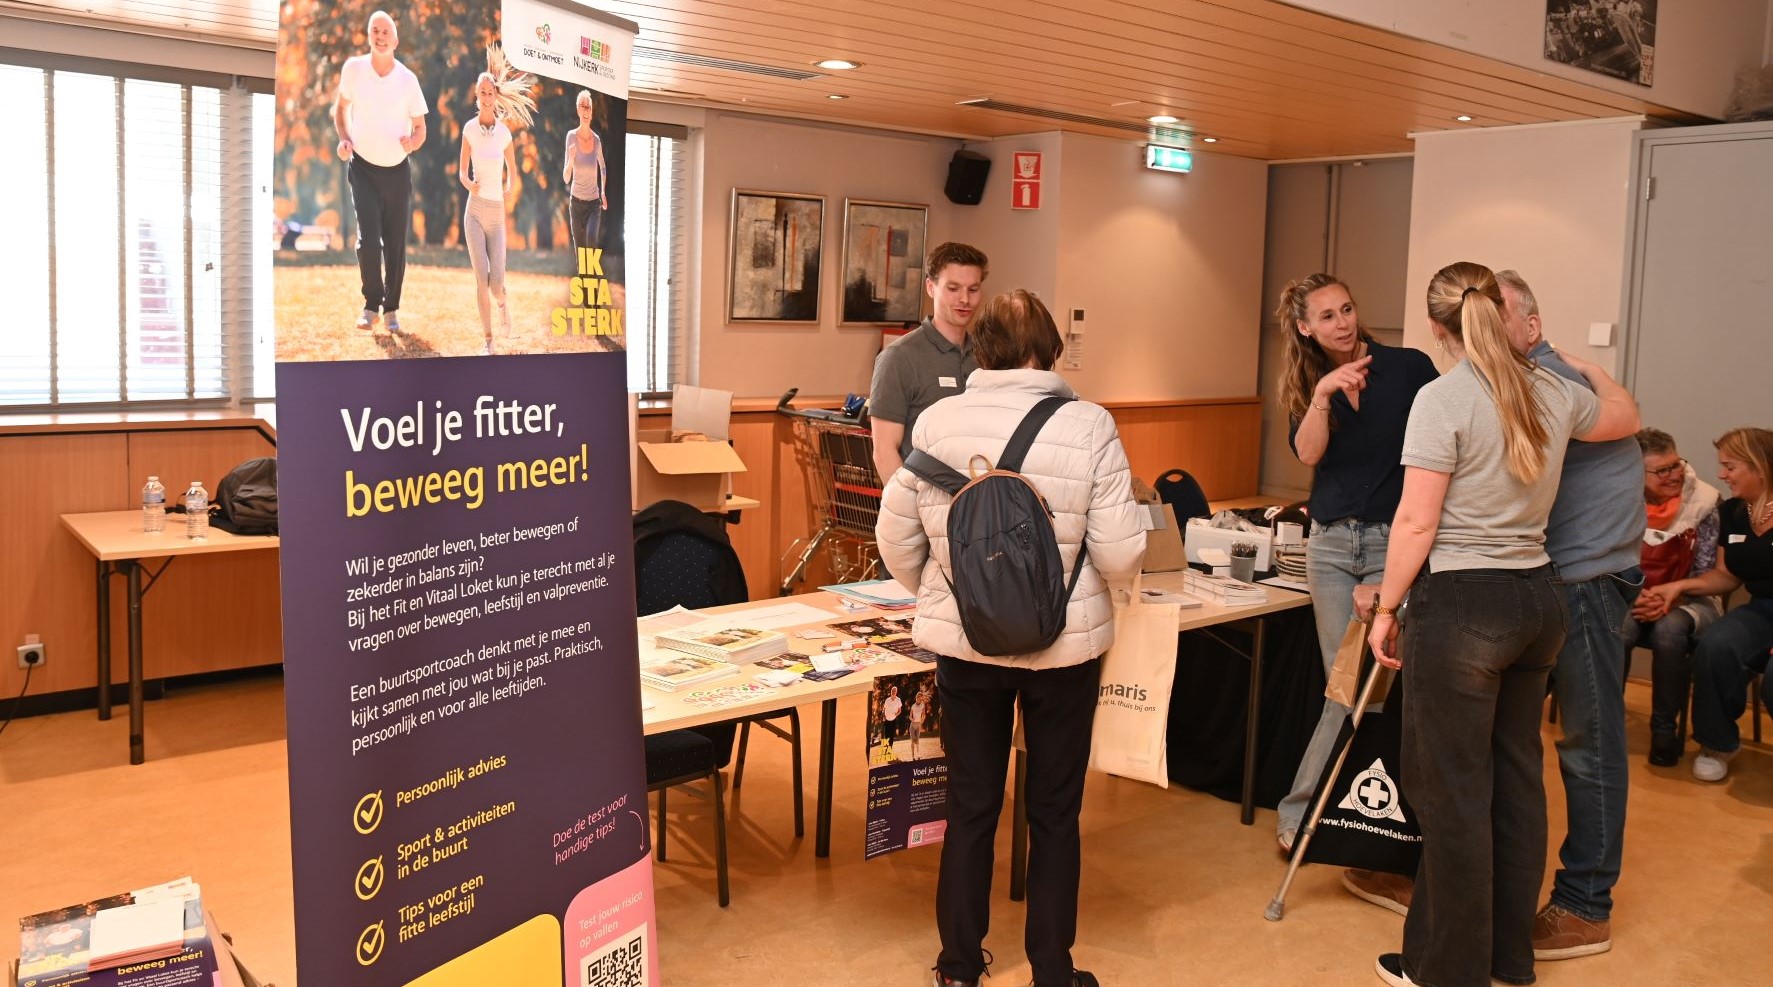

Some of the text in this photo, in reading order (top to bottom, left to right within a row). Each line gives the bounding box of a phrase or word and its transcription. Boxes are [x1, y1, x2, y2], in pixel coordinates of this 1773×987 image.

[523, 48, 536, 57] DOET
[541, 53, 564, 65] ONTMOET
[573, 55, 599, 75] NIJKERK
[577, 247, 604, 276] IK
[569, 276, 613, 306] STA
[550, 307, 623, 337] STERK
[340, 395, 564, 456] Voel je fitter,
[345, 443, 589, 518] beweeg meer!
[345, 516, 579, 577] Wil je gezonder leven, beter bewegen of
[346, 555, 485, 602] zekerder in balans zijn?
[348, 551, 616, 630] Bij het Fit en Vitaal Loket kun je terecht met al je
[348, 574, 609, 652] vragen over bewegen, leefstijl en valpreventie.
[350, 621, 591, 702] Een buurtsportcoach denkt met je mee en
[351, 636, 604, 729] kijkt samen met jou wat bij je past. Praktisch,
[1100, 684, 1147, 702] maris
[1117, 700, 1134, 710] thuis
[1134, 704, 1143, 713] bij
[352, 676, 547, 756] persoonlijk en voor alle leeftijden.
[396, 755, 507, 808] Persoonlijk advies
[912, 776, 937, 787] beweeg
[913, 767, 927, 776] Voel
[928, 766, 935, 776] je
[1368, 770, 1387, 781] FYSIO
[553, 793, 628, 848] Doe de test voor
[1353, 799, 1393, 817] HOEVELAKEN
[397, 801, 516, 861] Sport & activiteiten
[555, 816, 616, 866] handige tips!
[397, 837, 469, 880] in de buurt
[398, 875, 484, 923] Tips voor een
[398, 892, 475, 943] fitte leefstijl
[578, 891, 644, 932] Test jouw risico
[579, 920, 619, 949] op vallen
[117, 950, 203, 976] beweeg meer!
